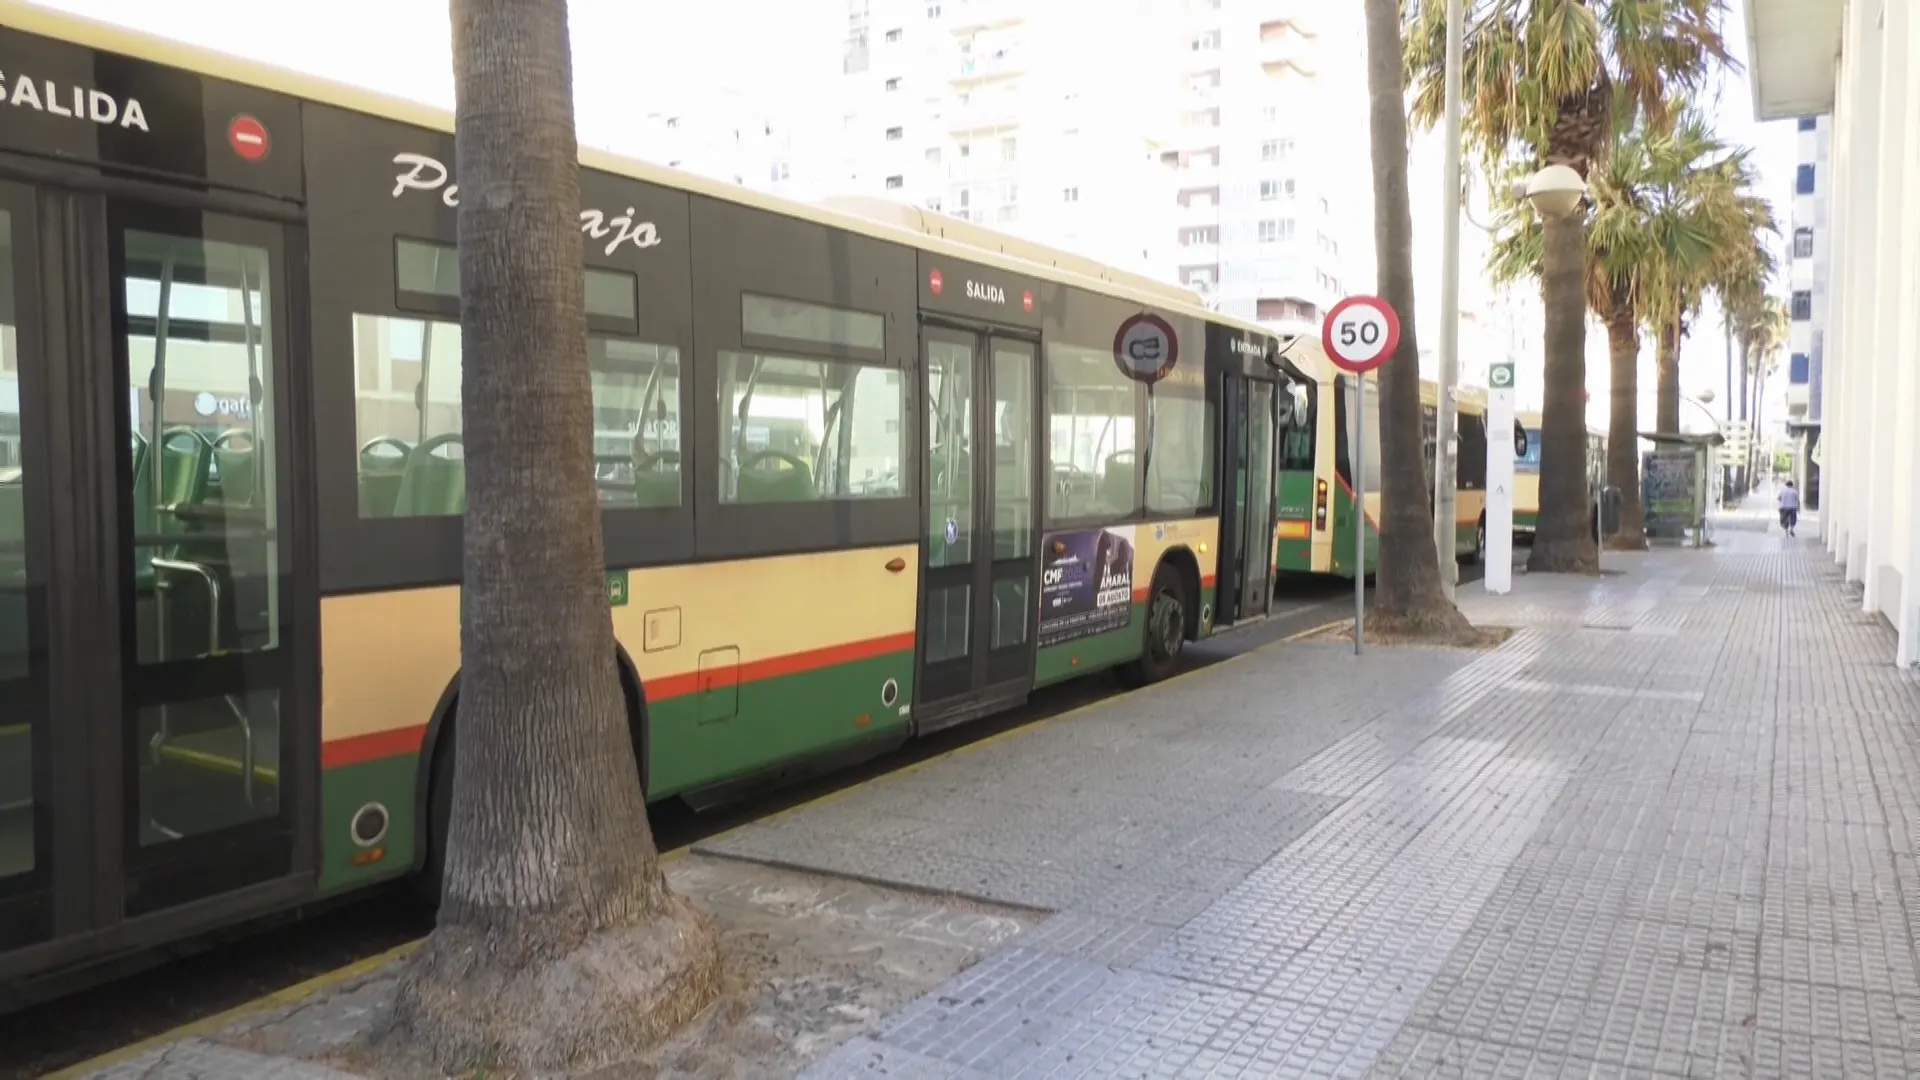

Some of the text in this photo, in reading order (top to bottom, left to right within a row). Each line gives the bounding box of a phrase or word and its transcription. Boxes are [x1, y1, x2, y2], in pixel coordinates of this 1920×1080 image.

[0, 69, 150, 132] ALIDA
[966, 280, 1005, 304] SALIDA
[1341, 320, 1379, 347] 50
[1100, 572, 1131, 589] AMARAL
